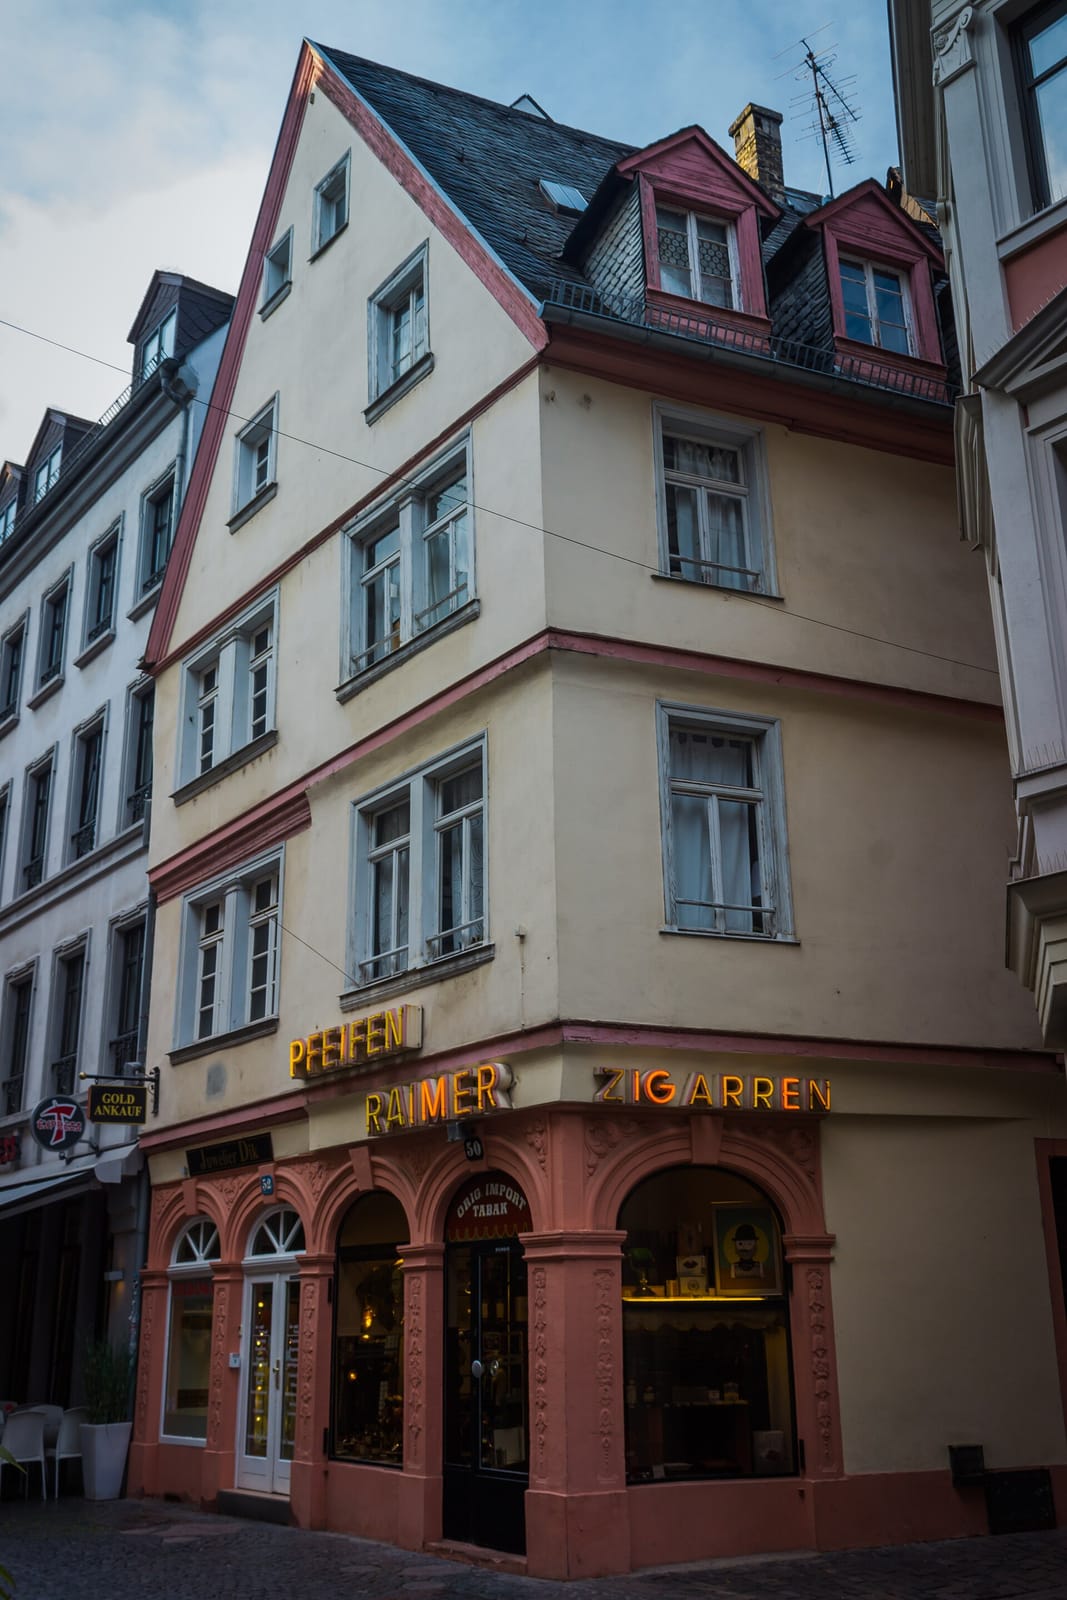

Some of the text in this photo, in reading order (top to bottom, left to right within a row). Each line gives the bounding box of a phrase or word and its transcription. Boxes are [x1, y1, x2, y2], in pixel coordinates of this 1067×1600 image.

[289, 1006, 405, 1078] PFEIFEN
[101, 1093, 136, 1105] GOLD
[365, 1064, 499, 1133] RAIMER
[597, 1068, 831, 1110] ZIGARREN
[94, 1105, 143, 1117] ANKAUF
[465, 1140, 482, 1158] 50
[456, 1183, 527, 1219] ORIG IMPORT
[472, 1202, 508, 1218] TABAK
